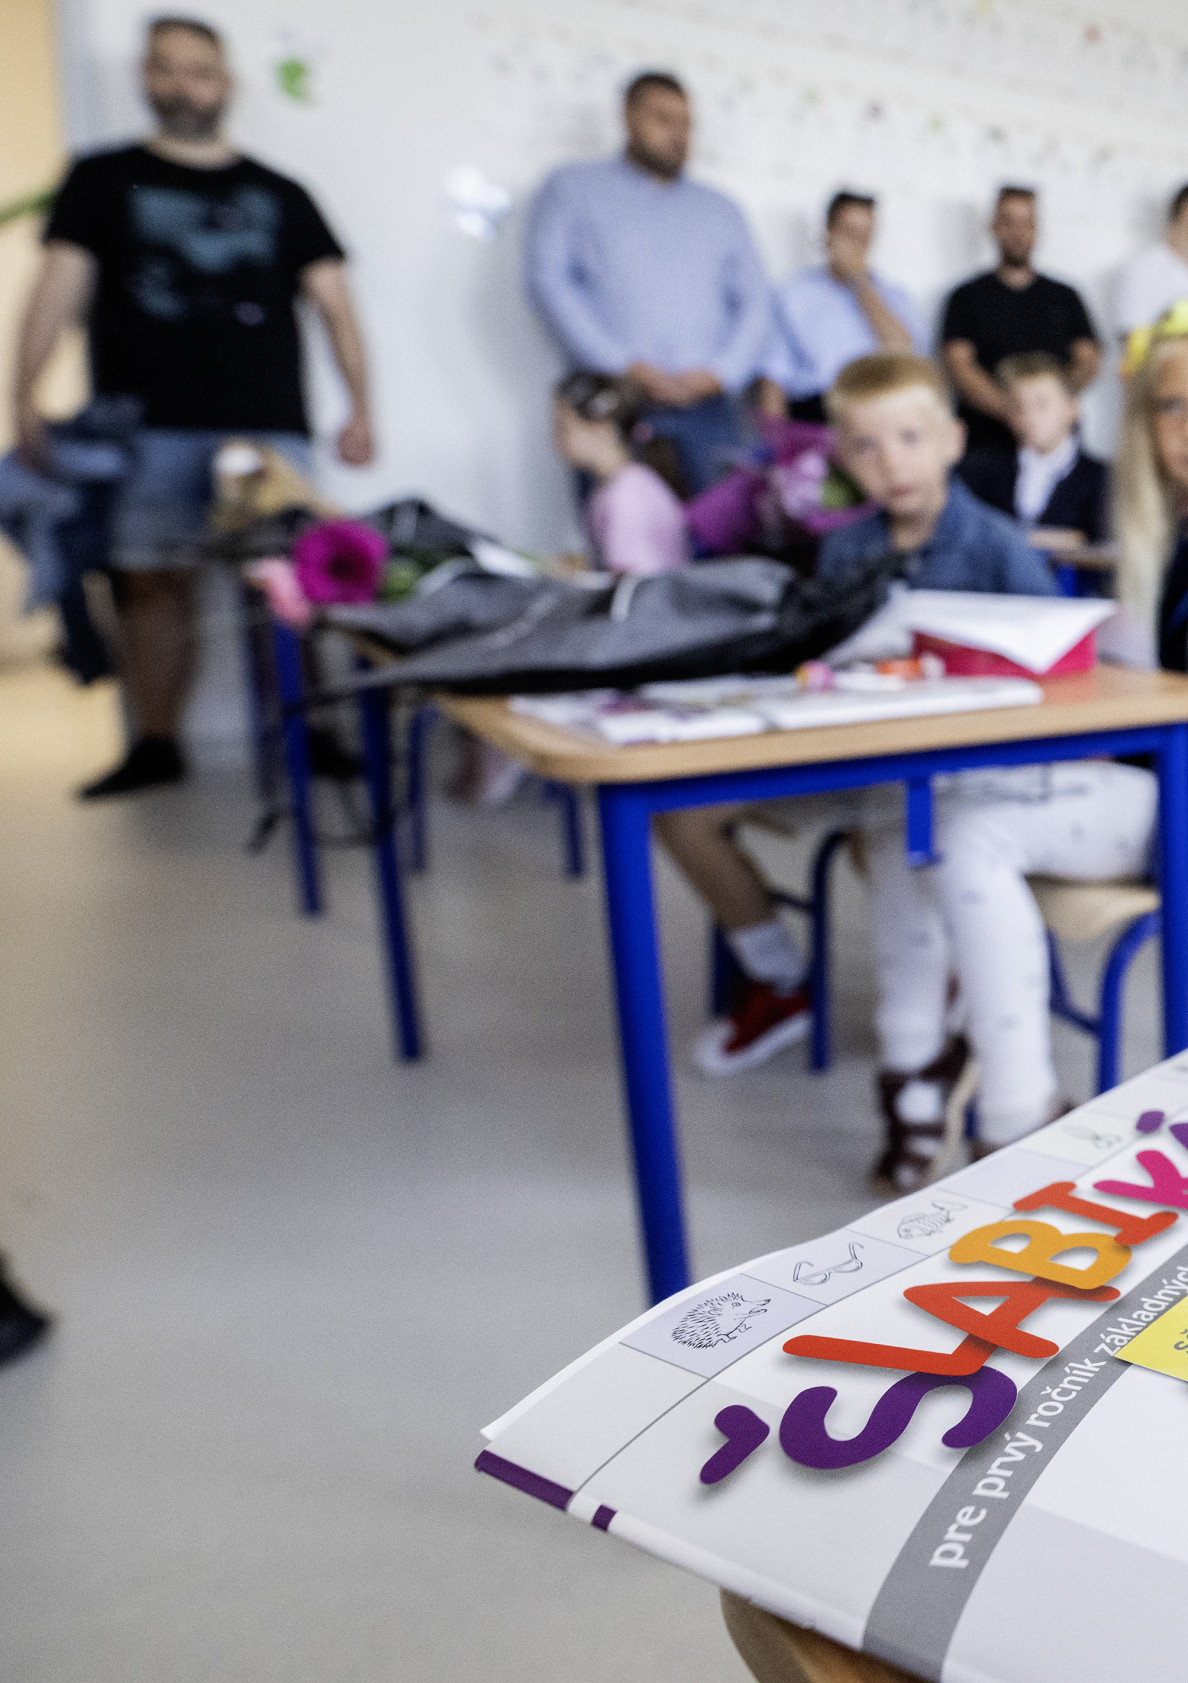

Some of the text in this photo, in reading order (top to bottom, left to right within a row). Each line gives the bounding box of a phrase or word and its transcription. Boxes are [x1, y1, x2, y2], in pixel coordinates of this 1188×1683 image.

[929, 1504, 988, 1569] pre
[972, 1431, 1043, 1500] prvý
[1025, 1357, 1108, 1428] ročník
